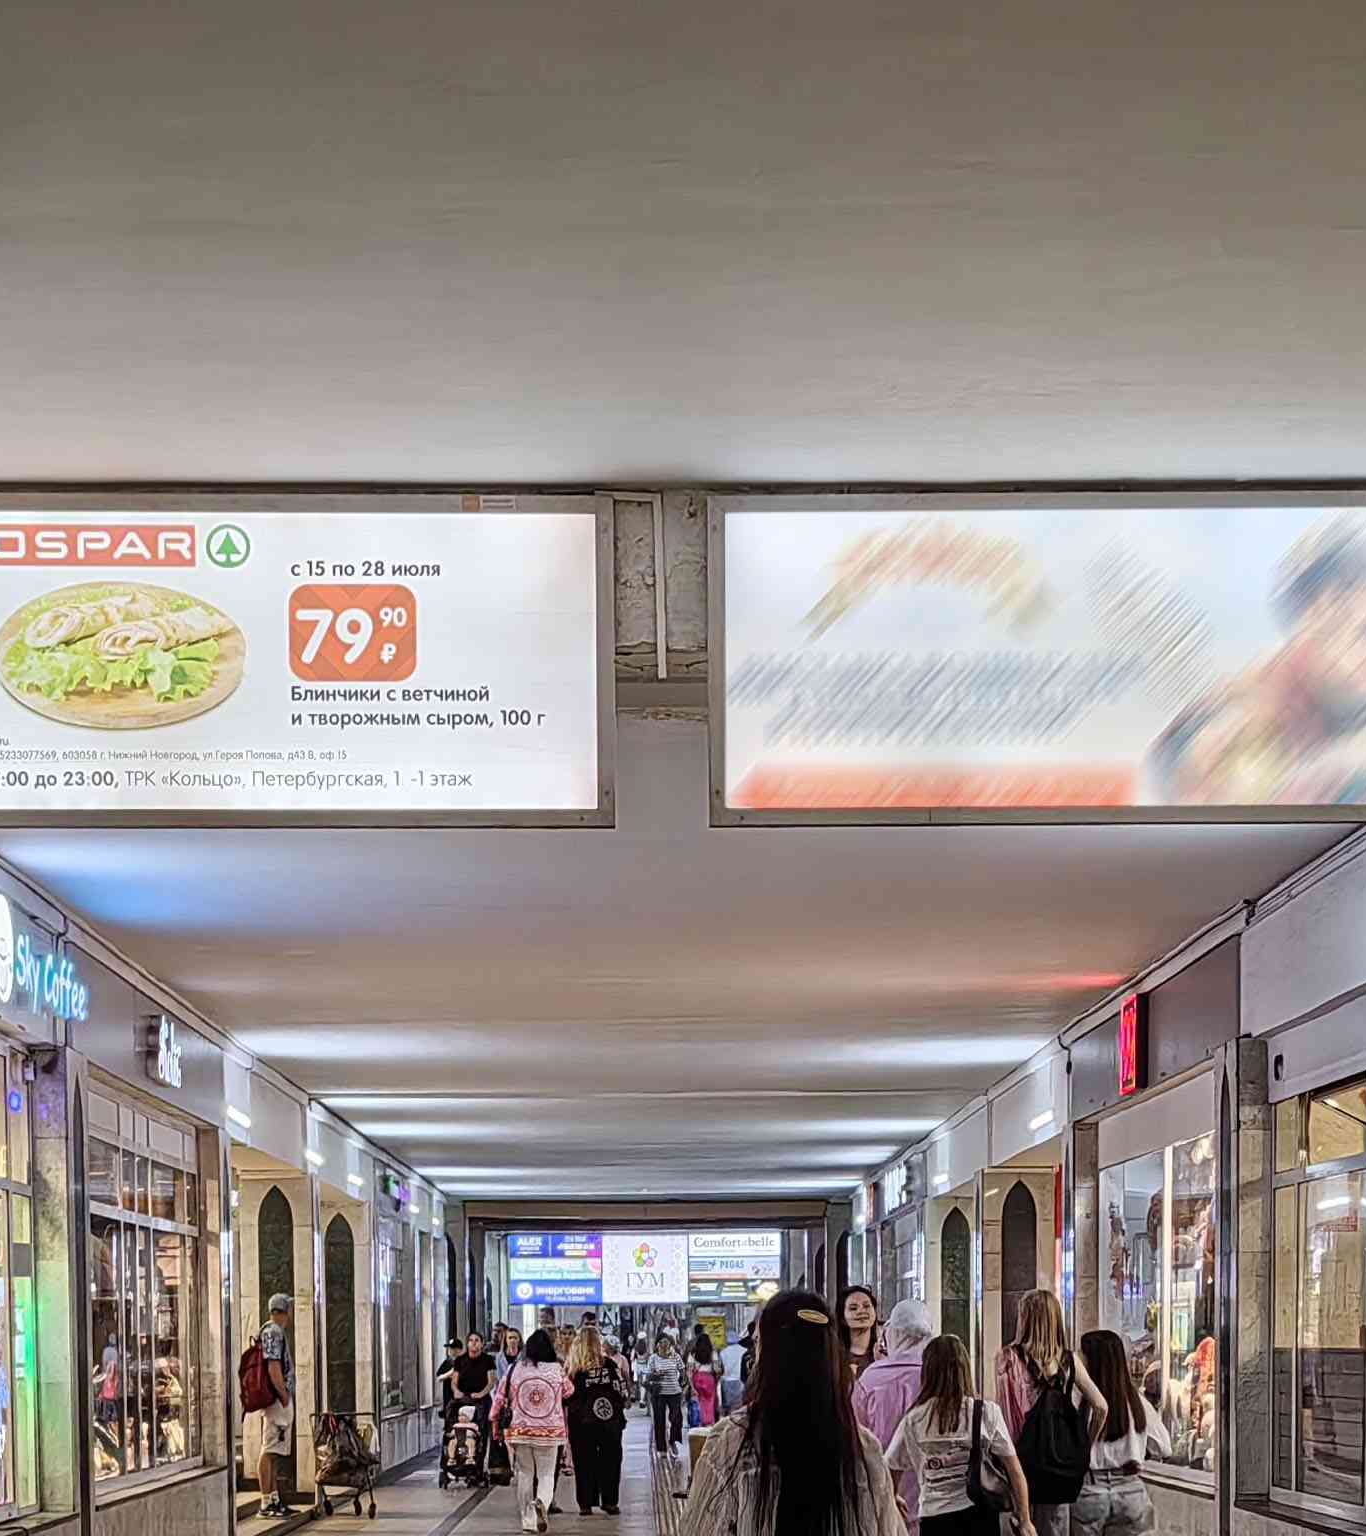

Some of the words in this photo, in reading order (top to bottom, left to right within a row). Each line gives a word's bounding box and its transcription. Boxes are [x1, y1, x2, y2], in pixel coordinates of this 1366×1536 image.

[291, 563, 301, 577] с
[307, 561, 325, 577] 15
[332, 563, 355, 577] по
[362, 561, 385, 577] 28
[391, 563, 441, 577] июля
[295, 608, 374, 664] 79
[379, 607, 407, 627] 90
[291, 685, 381, 701] Блинчики
[403, 685, 490, 701] ветчиной
[291, 712, 302, 726] и
[308, 712, 420, 729] творожным
[427, 712, 494, 729] сыром,
[500, 710, 531, 726] 100
[538, 712, 546, 726] г
[108, 749, 147, 760] Нижний
[150, 750, 200, 761] Новгород,
[34, 774, 57, 789] до
[63, 771, 119, 789] 23:00,
[124, 770, 156, 786] ТРК
[161, 770, 245, 789] «Кольцо»,
[251, 771, 387, 790] Петербургская,
[430, 774, 473, 787] этаж
[16, 934, 41, 1014] Sky
[44, 954, 88, 1021] Coffee
